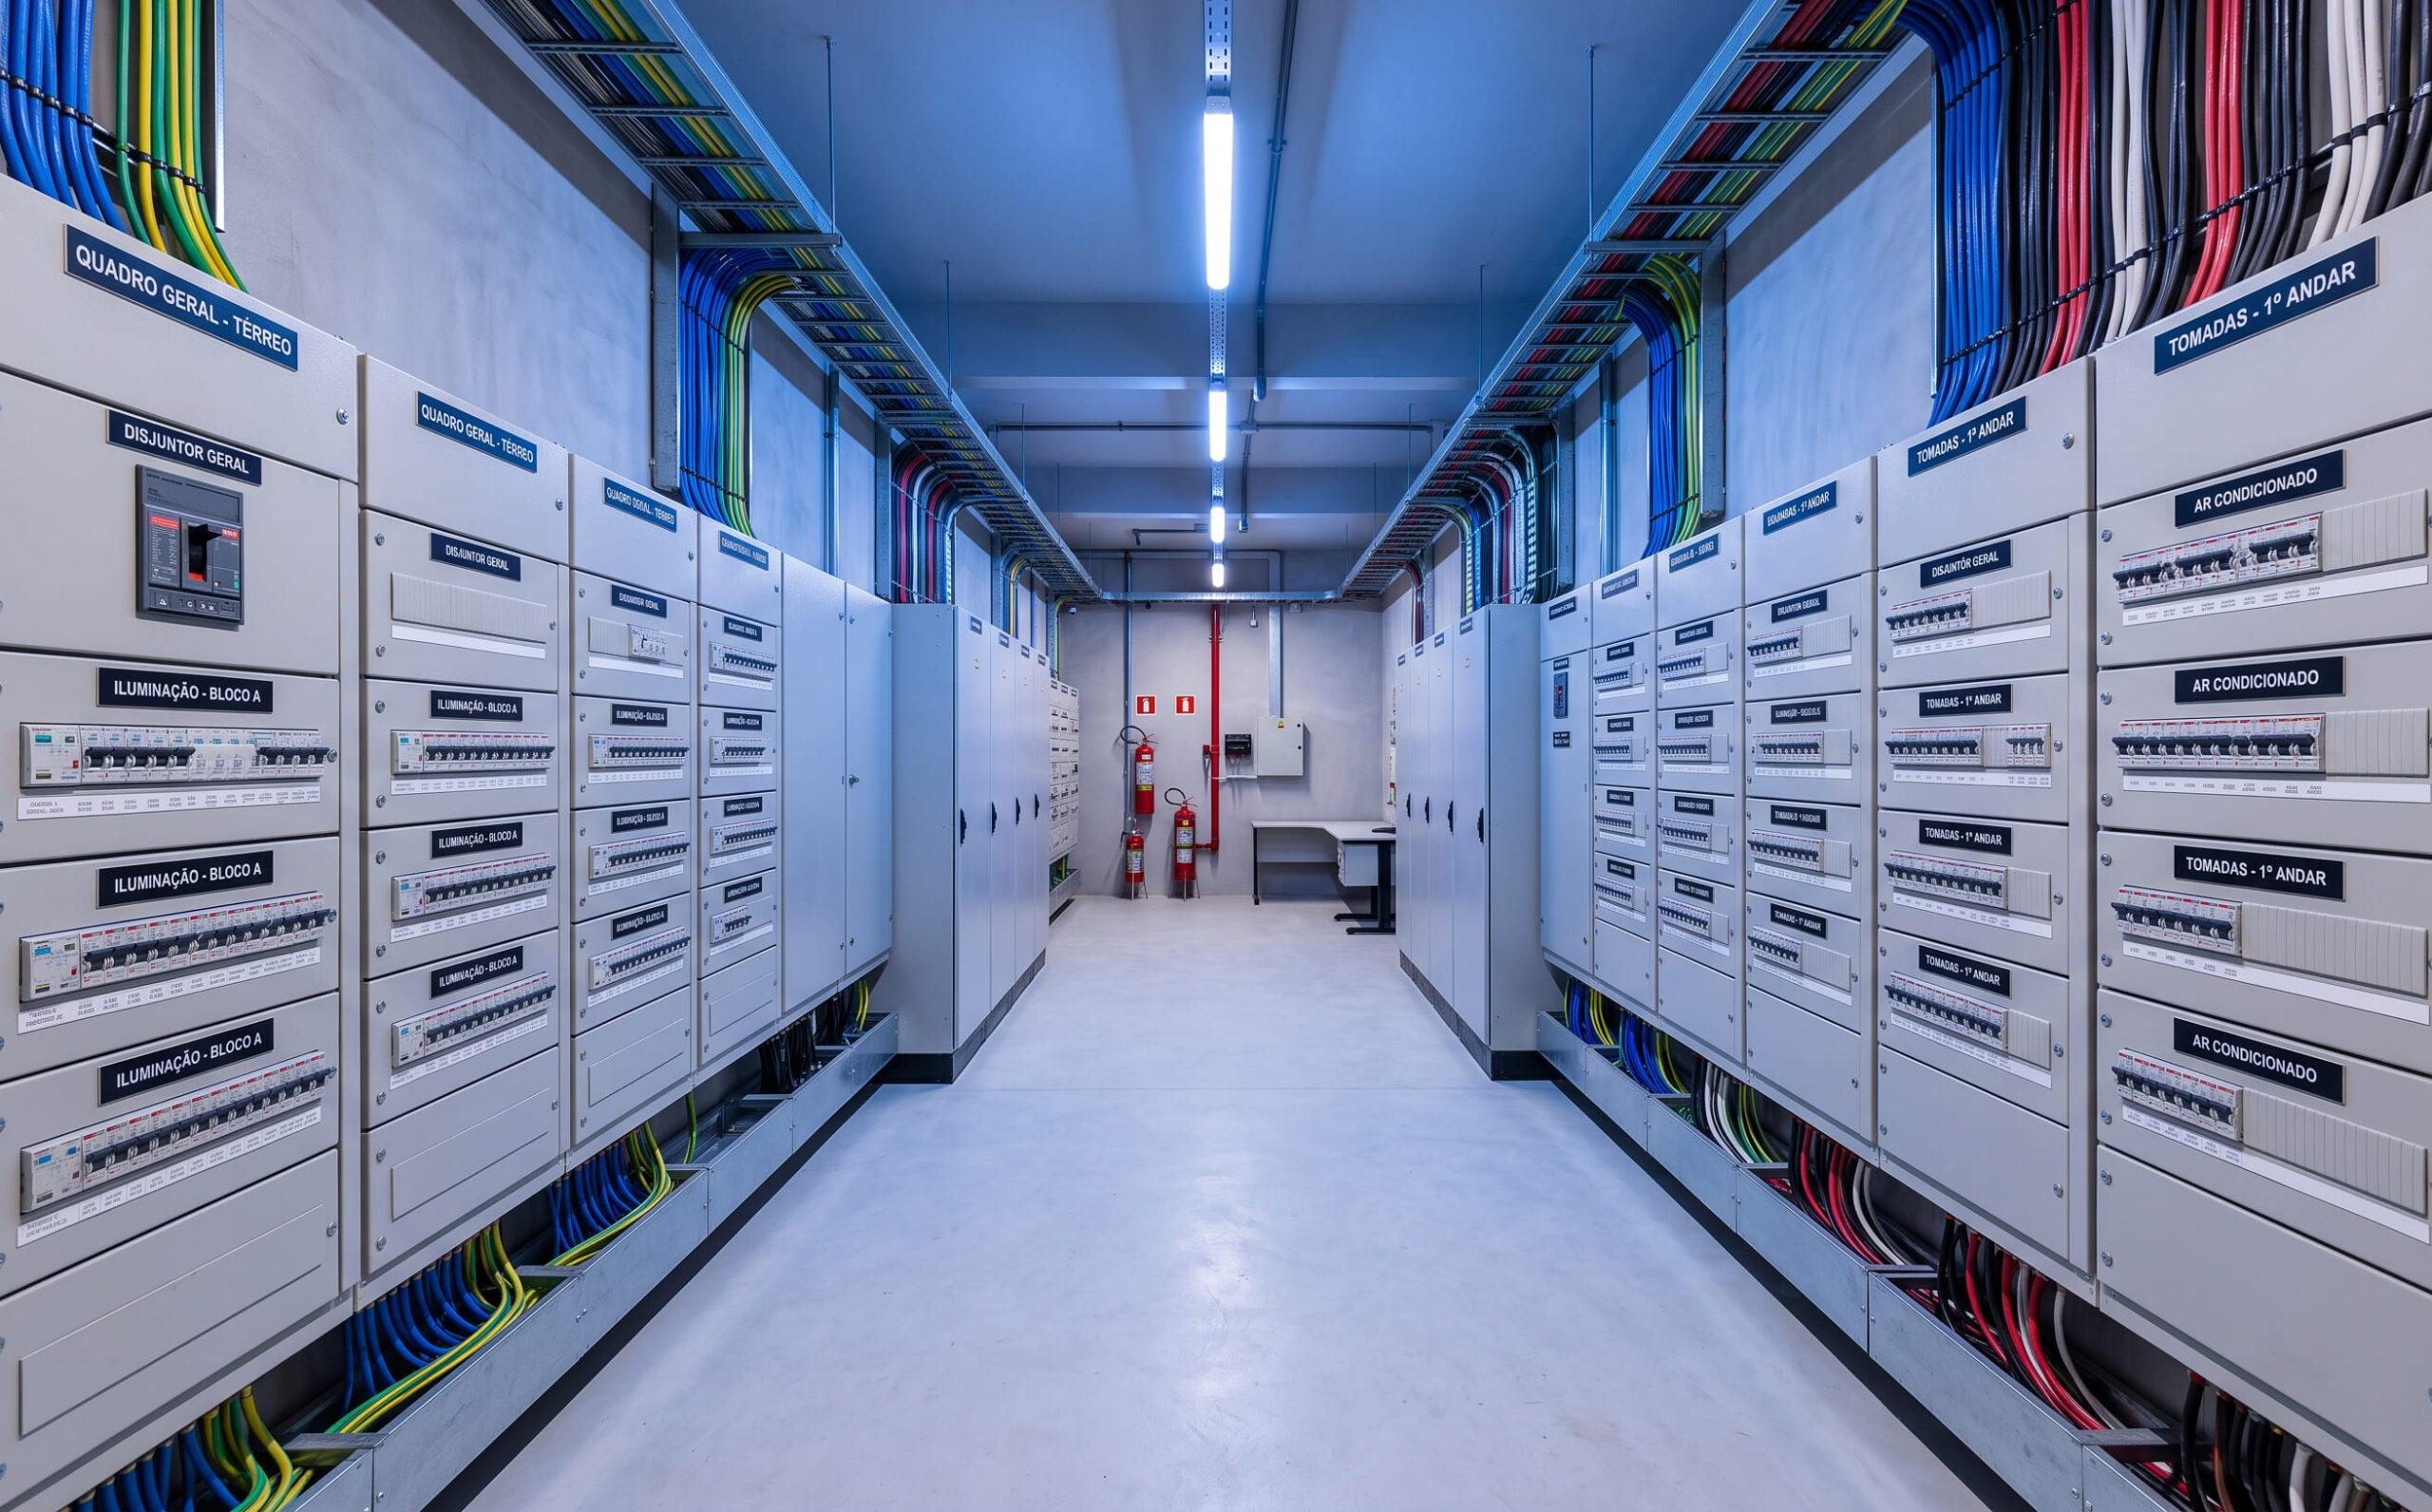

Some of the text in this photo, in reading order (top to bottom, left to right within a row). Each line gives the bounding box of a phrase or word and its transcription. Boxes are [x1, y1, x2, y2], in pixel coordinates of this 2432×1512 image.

[76, 245, 158, 296] QUADRO
[162, 284, 218, 325] GERAL
[233, 316, 292, 356] TÉRREO
[2168, 308, 2248, 356] TOMADAS
[2264, 293, 2281, 315] 1º
[2286, 260, 2356, 308] ANDAR
[421, 404, 464, 434] QUADRO
[466, 425, 495, 448] GERAL
[1916, 435, 1959, 464] TOMADAS
[1979, 411, 2014, 438] ANDAR
[124, 424, 249, 474] DISJUNTOR GERAL
[2194, 468, 2317, 513] AR CONDICIONADO
[1972, 551, 1999, 568] GERAL
[114, 680, 199, 701] ILUMINAÇÃO
[210, 687, 251, 702] BLOCO
[252, 690, 261, 702] A
[2193, 670, 2319, 692] AR CONDICIONADO
[1974, 832, 2002, 845] ANDAR
[115, 868, 199, 893] ILUMINAÇÃO
[210, 864, 251, 880] BLOCO
[251, 862, 261, 875] A
[2186, 857, 2248, 877] TOMADAS
[2259, 865, 2273, 879] 1º
[2275, 866, 2327, 886] ANDAR
[1926, 954, 1959, 973] TOMADAS
[1973, 971, 2001, 987] ANDAR
[116, 1049, 200, 1087] ILUMINAÇÃO
[211, 1035, 252, 1059] BLOCO
[253, 1032, 262, 1046] A
[2193, 1034, 2317, 1083] AR CONDICIONADO
